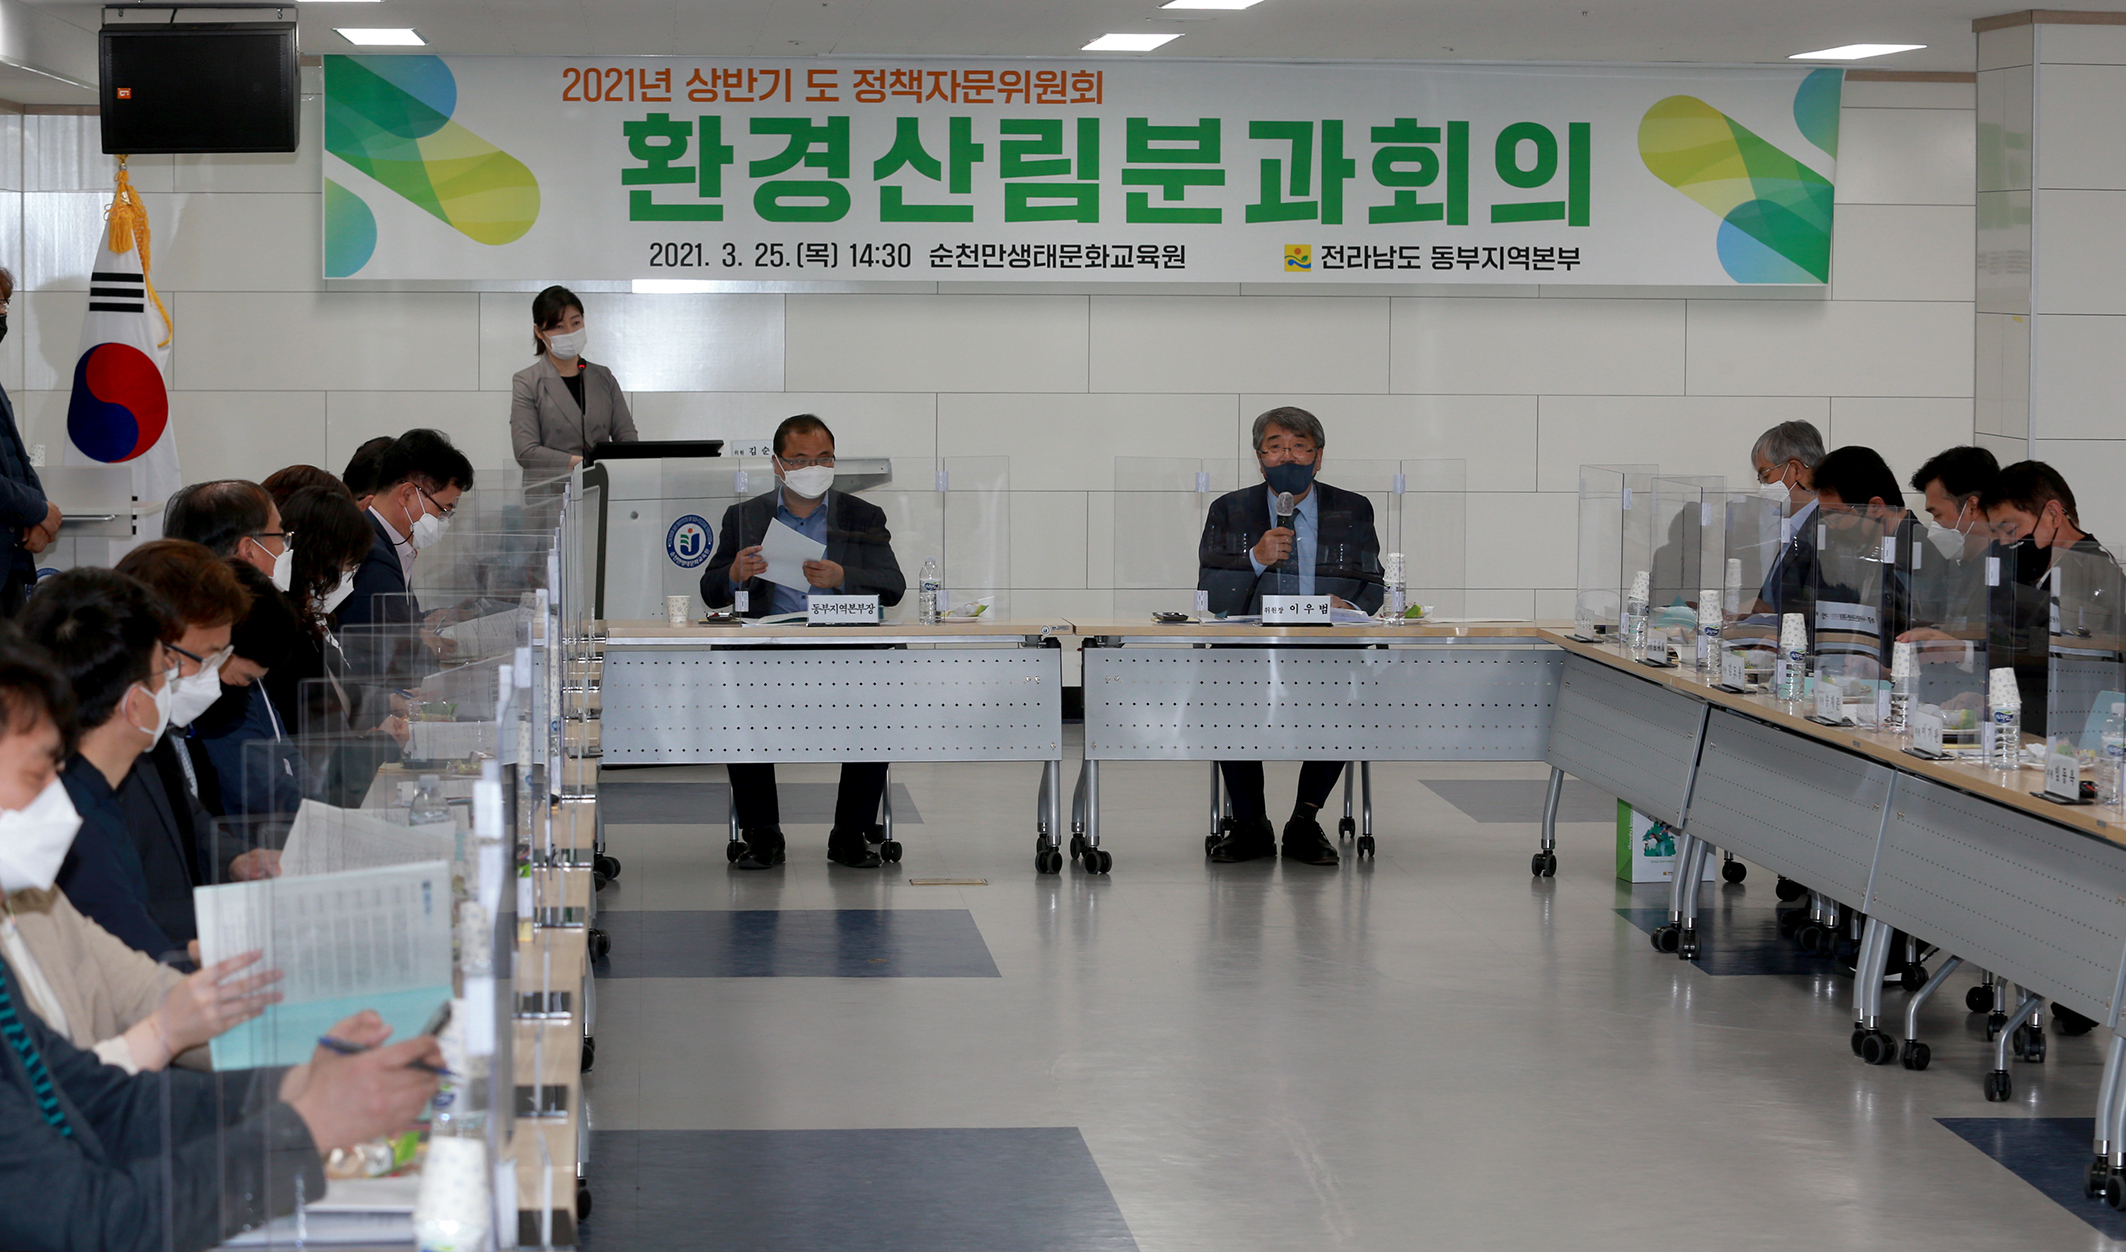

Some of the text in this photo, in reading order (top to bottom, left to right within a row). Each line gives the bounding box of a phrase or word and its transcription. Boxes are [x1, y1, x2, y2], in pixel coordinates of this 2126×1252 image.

[562, 67, 1103, 105] 2021년 상반기 도 정책자문위원회
[621, 112, 1591, 227] 환경산림분과회의
[649, 242, 710, 268] 2021.
[722, 242, 743, 268] 3.
[849, 242, 911, 268] 14:30
[929, 242, 1186, 269] 순천만생태문화교육원
[1321, 244, 1581, 272] 전라남도 동부지역본부
[811, 603, 876, 615] 동부지역본부장
[1264, 606, 1285, 614] 위원장
